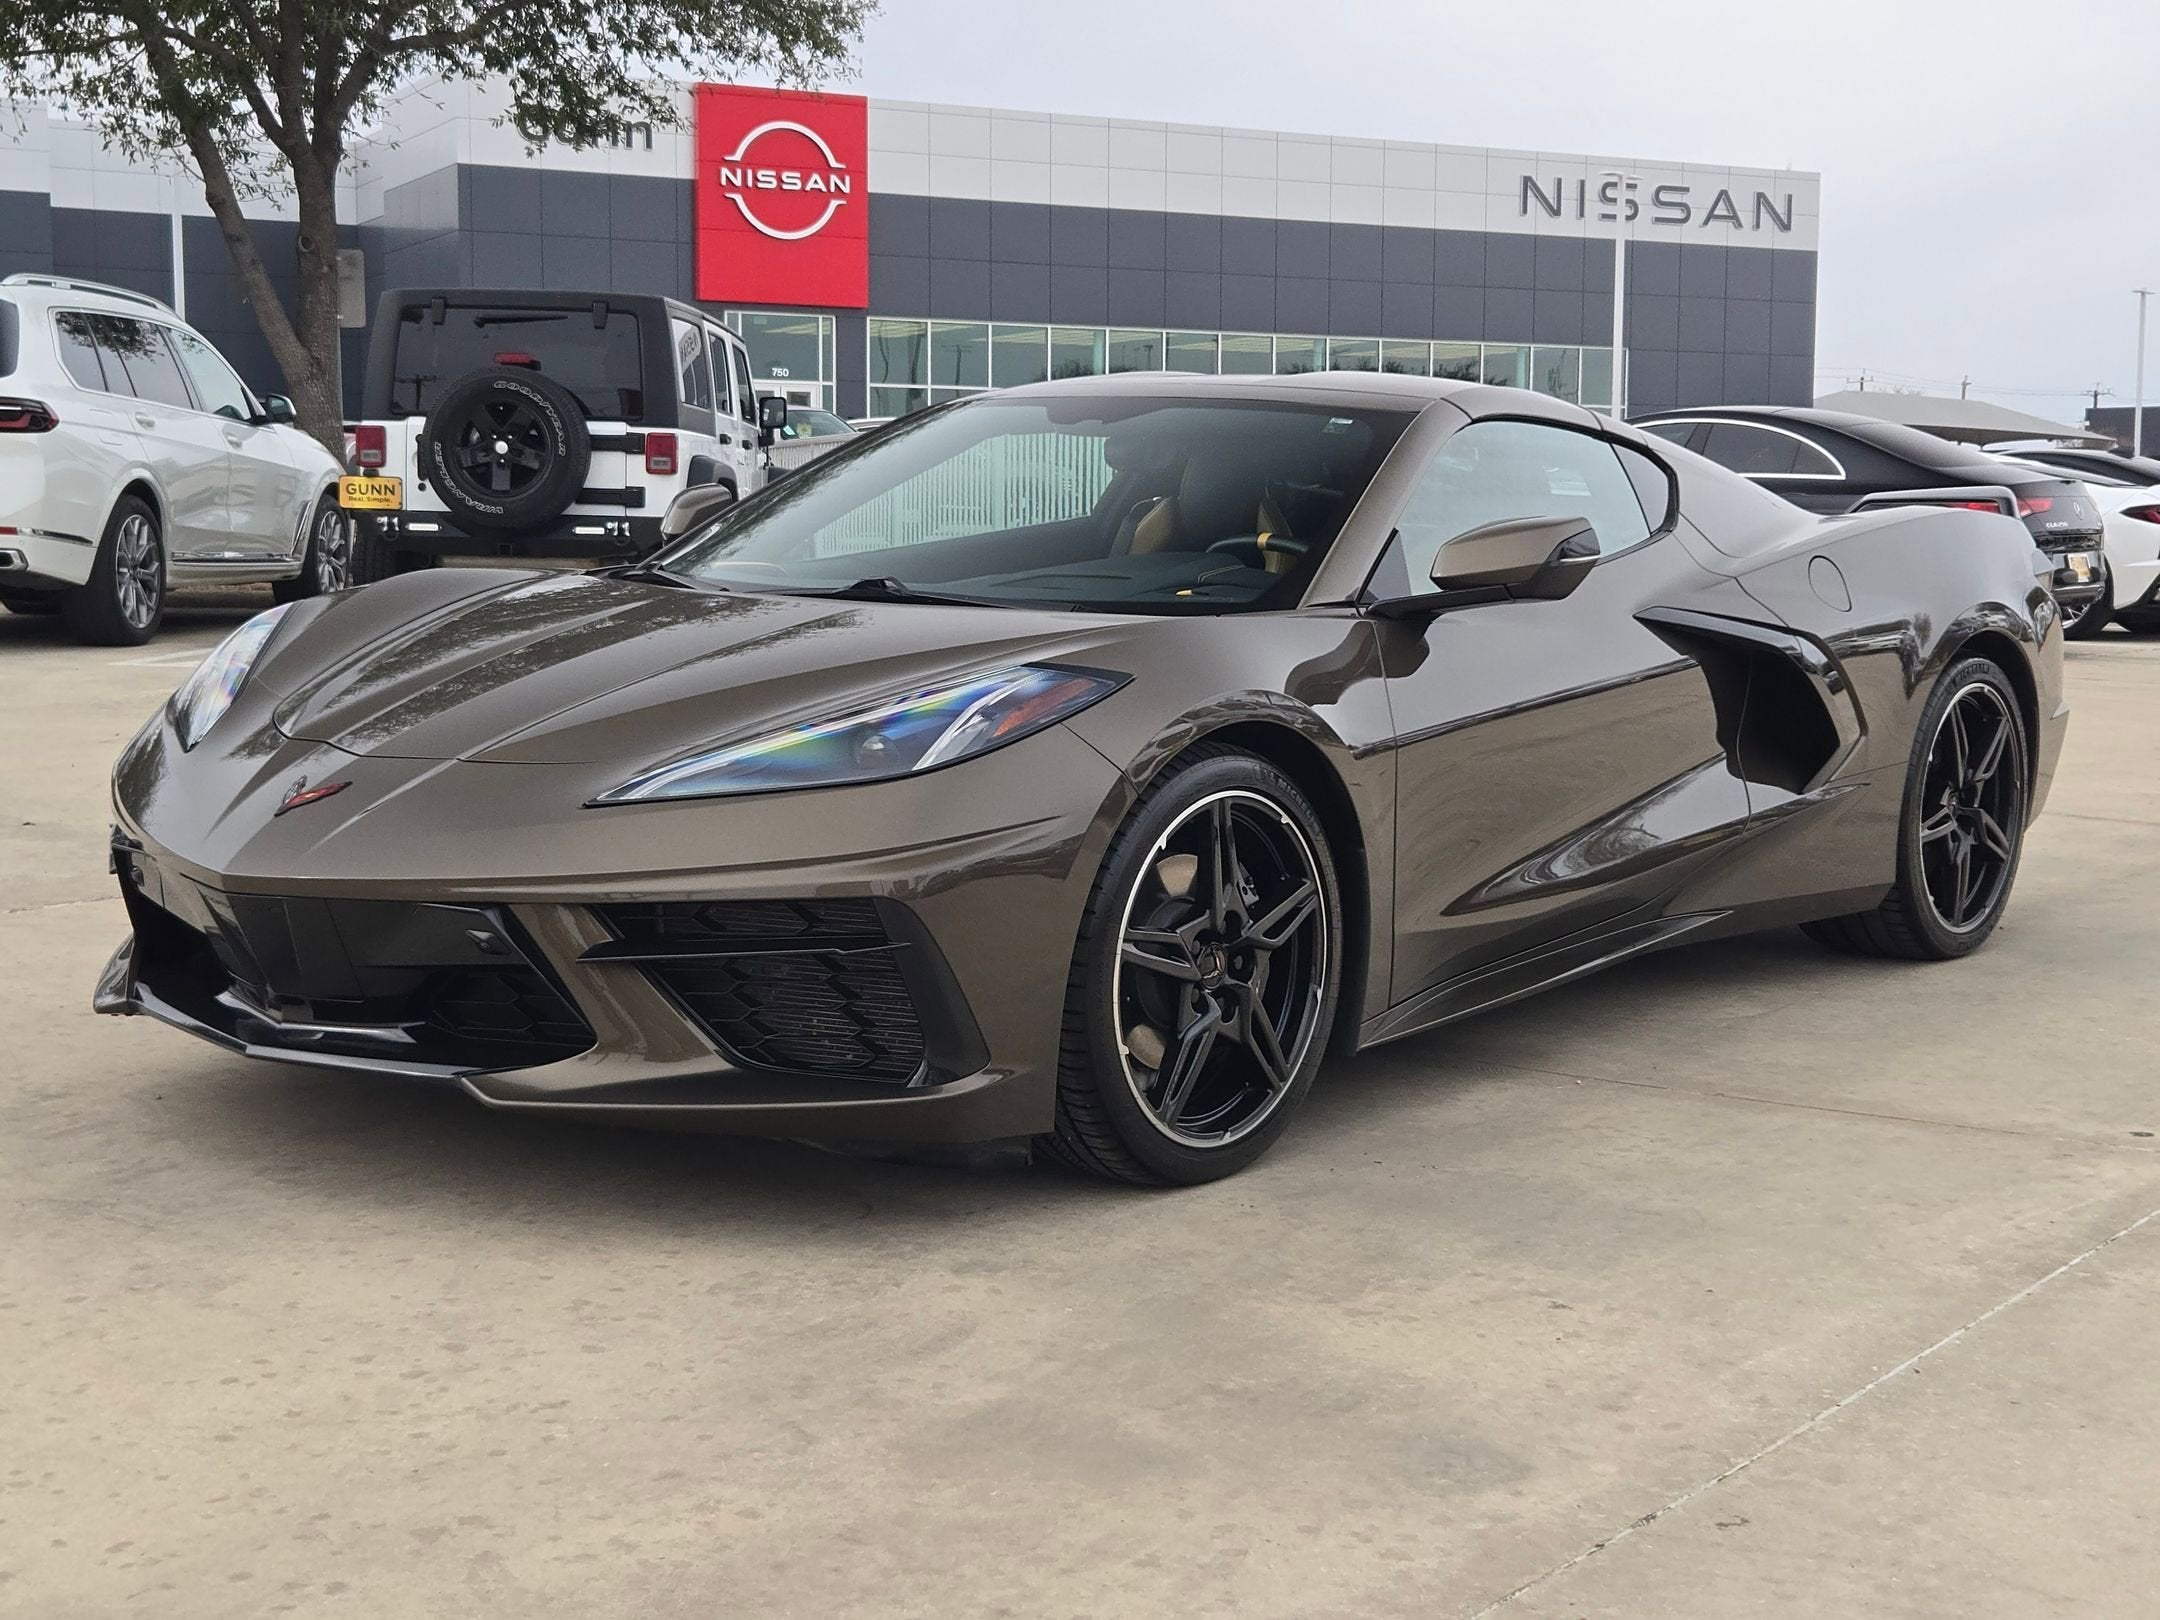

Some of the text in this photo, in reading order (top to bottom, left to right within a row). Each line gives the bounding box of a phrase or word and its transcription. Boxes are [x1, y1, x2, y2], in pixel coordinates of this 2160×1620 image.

[720, 166, 851, 194] NISSAN
[1520, 175, 1793, 232] NISSAN
[771, 367, 790, 377] 750
[493, 380, 566, 456] GOODYEAR
[345, 483, 396, 496] GUNN
[434, 441, 503, 514] WRANGLER
